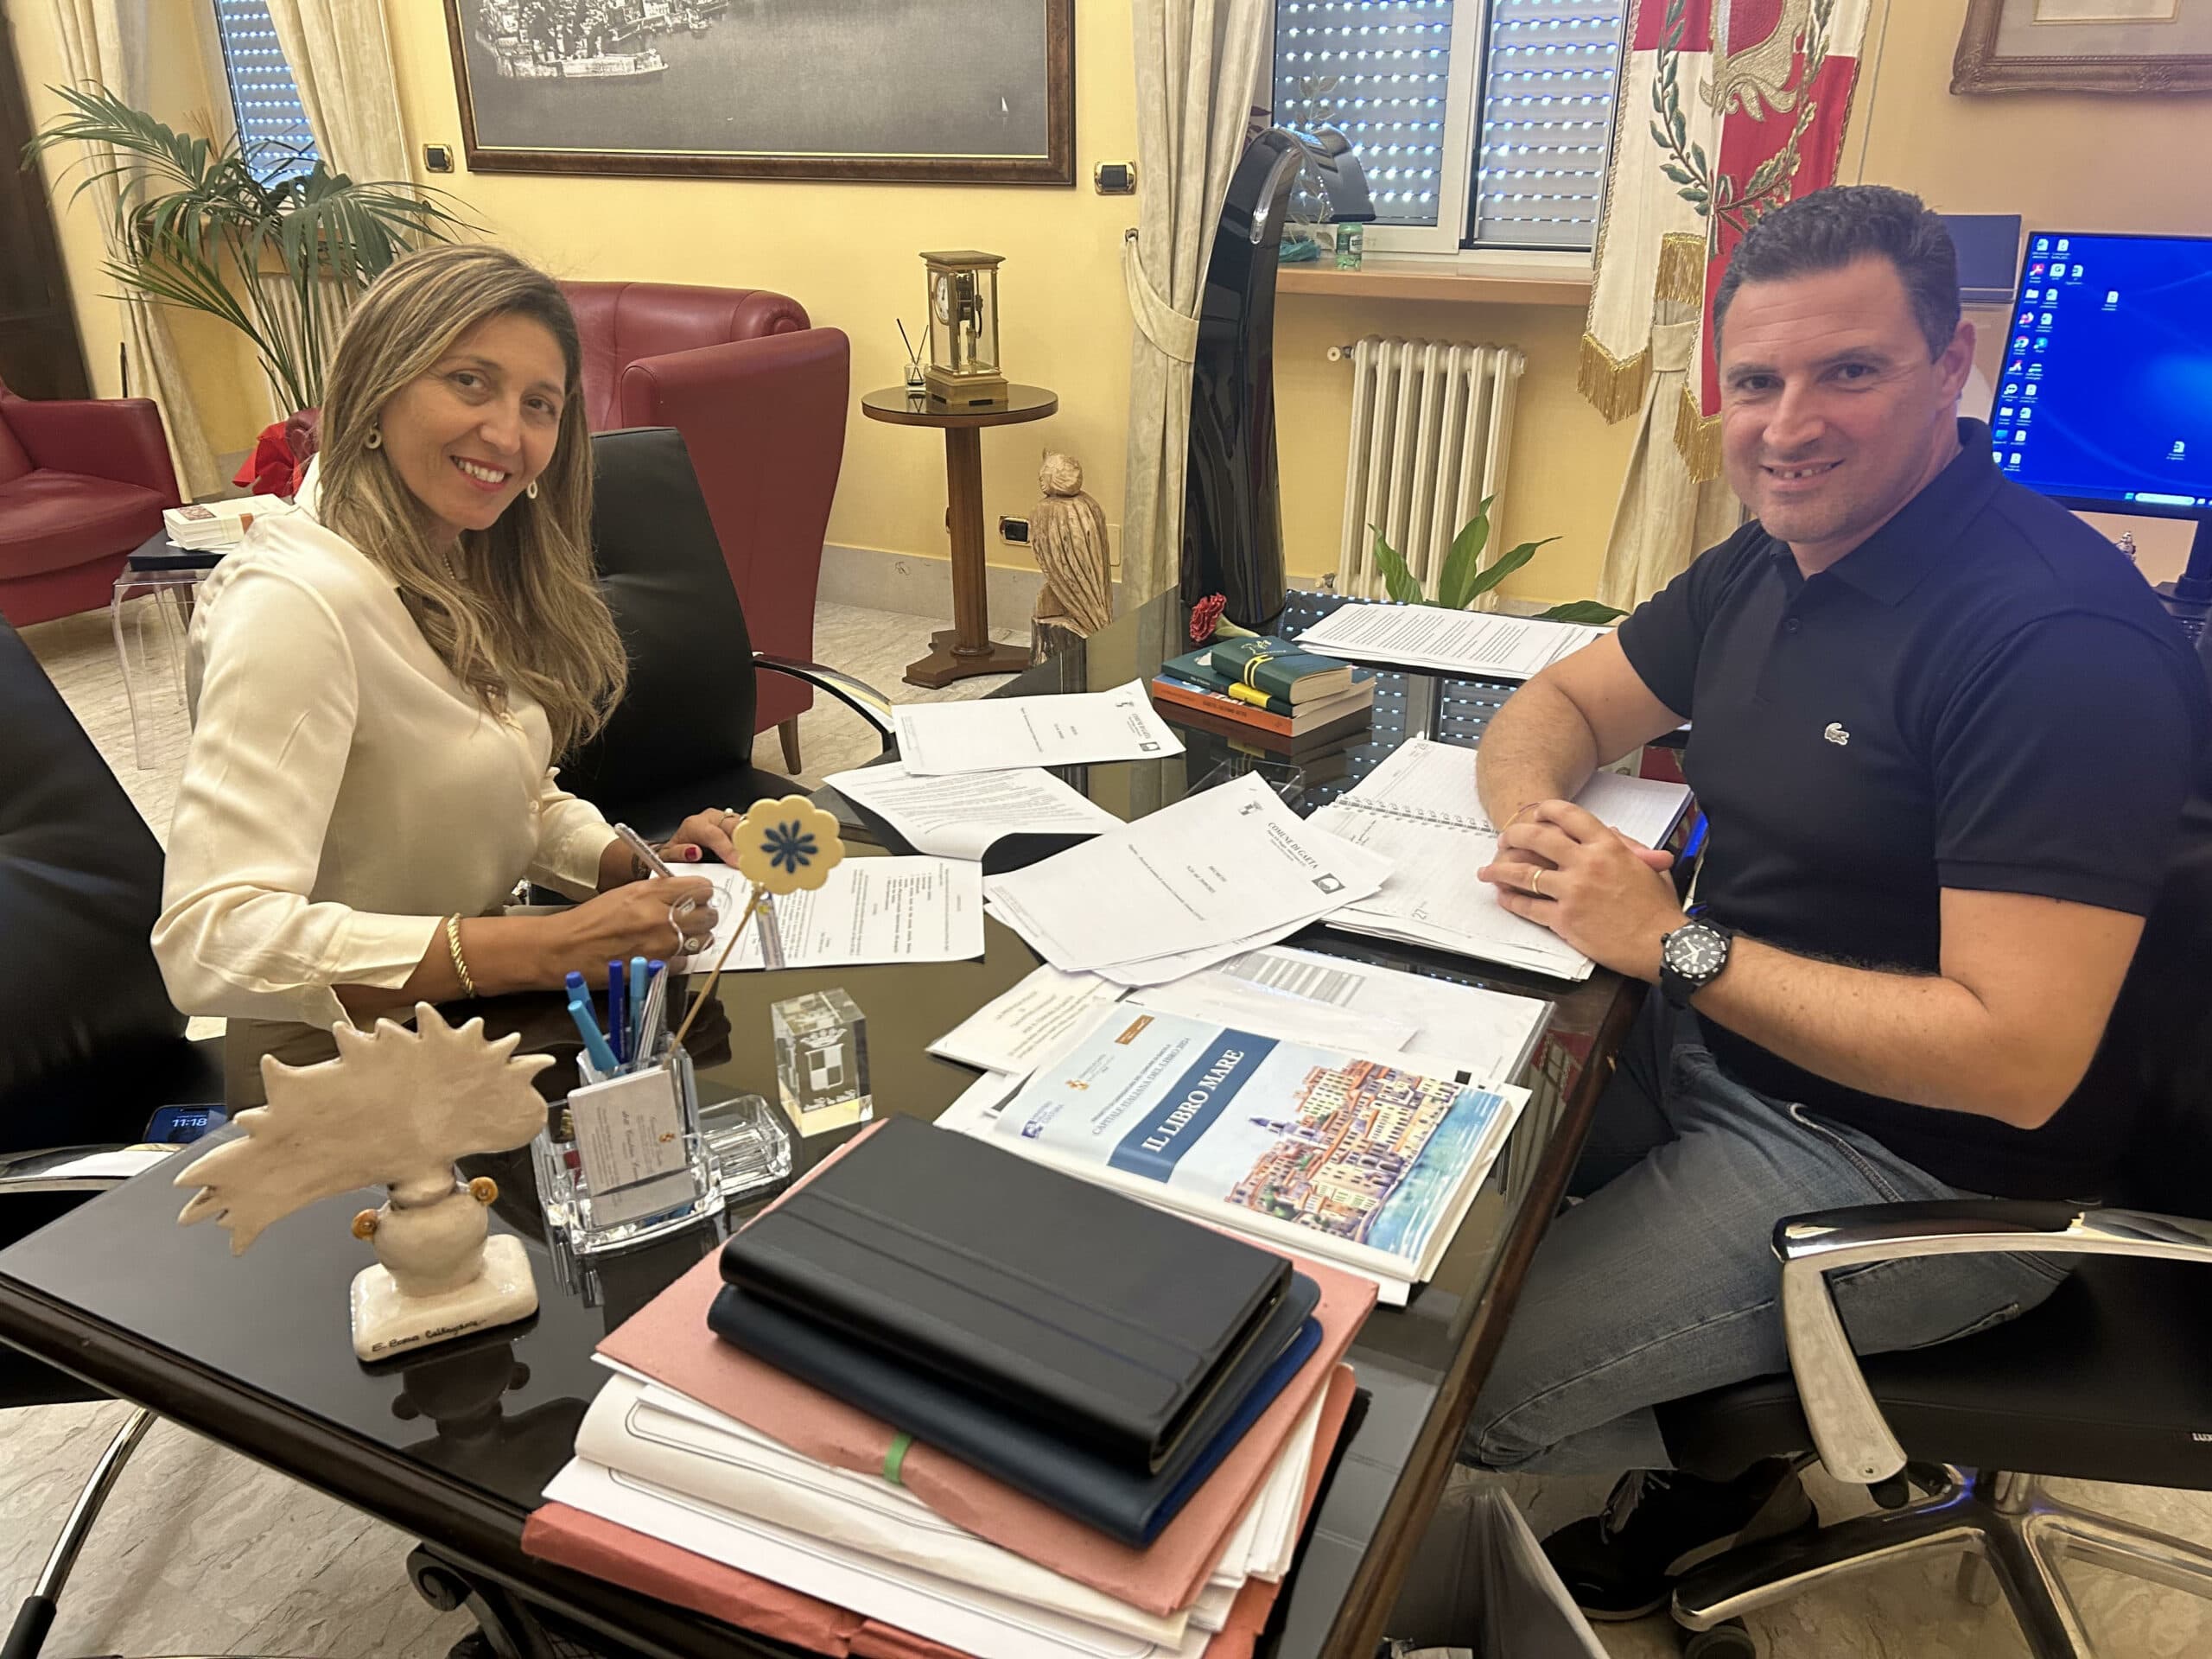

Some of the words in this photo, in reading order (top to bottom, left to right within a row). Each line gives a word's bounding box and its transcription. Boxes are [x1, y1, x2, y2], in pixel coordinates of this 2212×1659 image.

[1268, 821, 1294, 845] COMUNE
[1290, 842, 1301, 852] DI
[1297, 848, 1319, 869] GAETA
[172, 1117, 208, 1128] 11:18
[1141, 1136, 1170, 1153] IL
[1157, 1090, 1209, 1136] LIBRO
[1198, 1049, 1244, 1090] MARE
